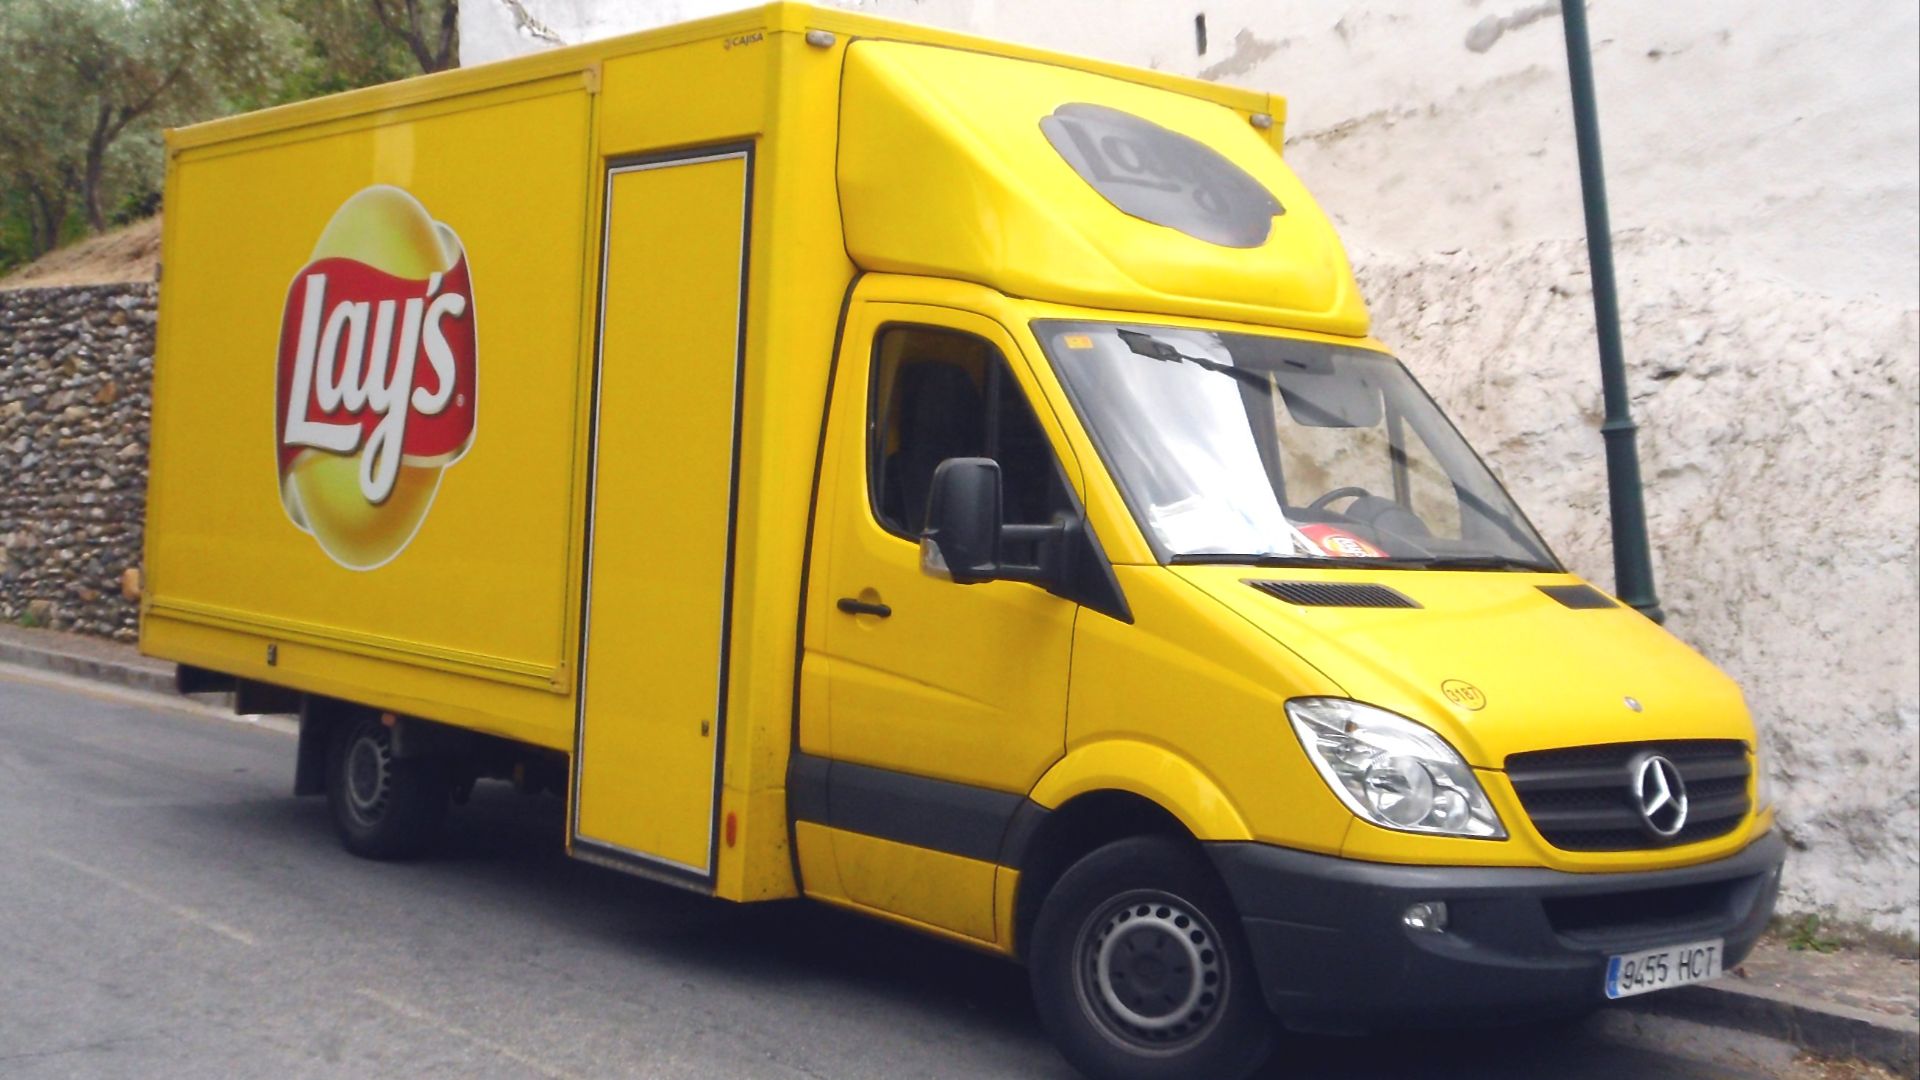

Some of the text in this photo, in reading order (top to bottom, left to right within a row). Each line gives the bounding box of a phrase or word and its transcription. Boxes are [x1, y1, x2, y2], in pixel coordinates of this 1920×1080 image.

[284, 271, 466, 503] Lay's
[1446, 687, 1480, 702] 3187
[1622, 946, 1716, 990] 9455 HCT
